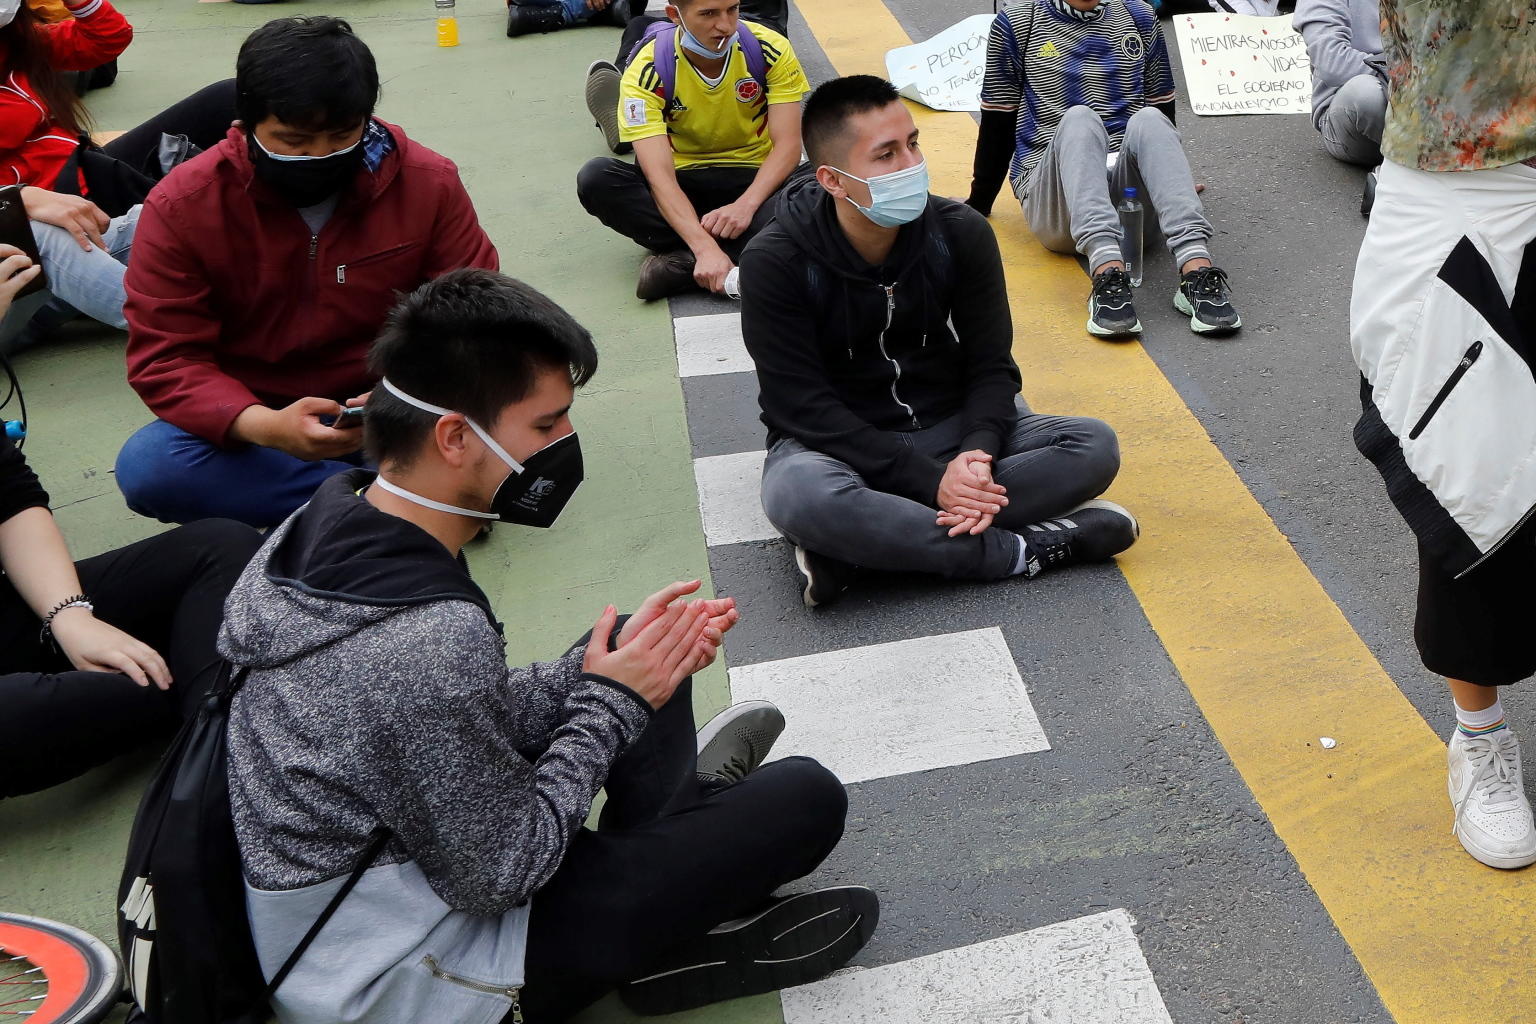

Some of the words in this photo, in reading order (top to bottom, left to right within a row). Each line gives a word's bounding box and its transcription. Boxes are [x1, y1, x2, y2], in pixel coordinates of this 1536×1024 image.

[1190, 34, 1260, 54] MIENTRAS
[1263, 54, 1311, 73] VIDAS
[944, 65, 984, 91] TENGO
[1217, 83, 1238, 95] EL
[1243, 80, 1305, 94] GOBIERNO
